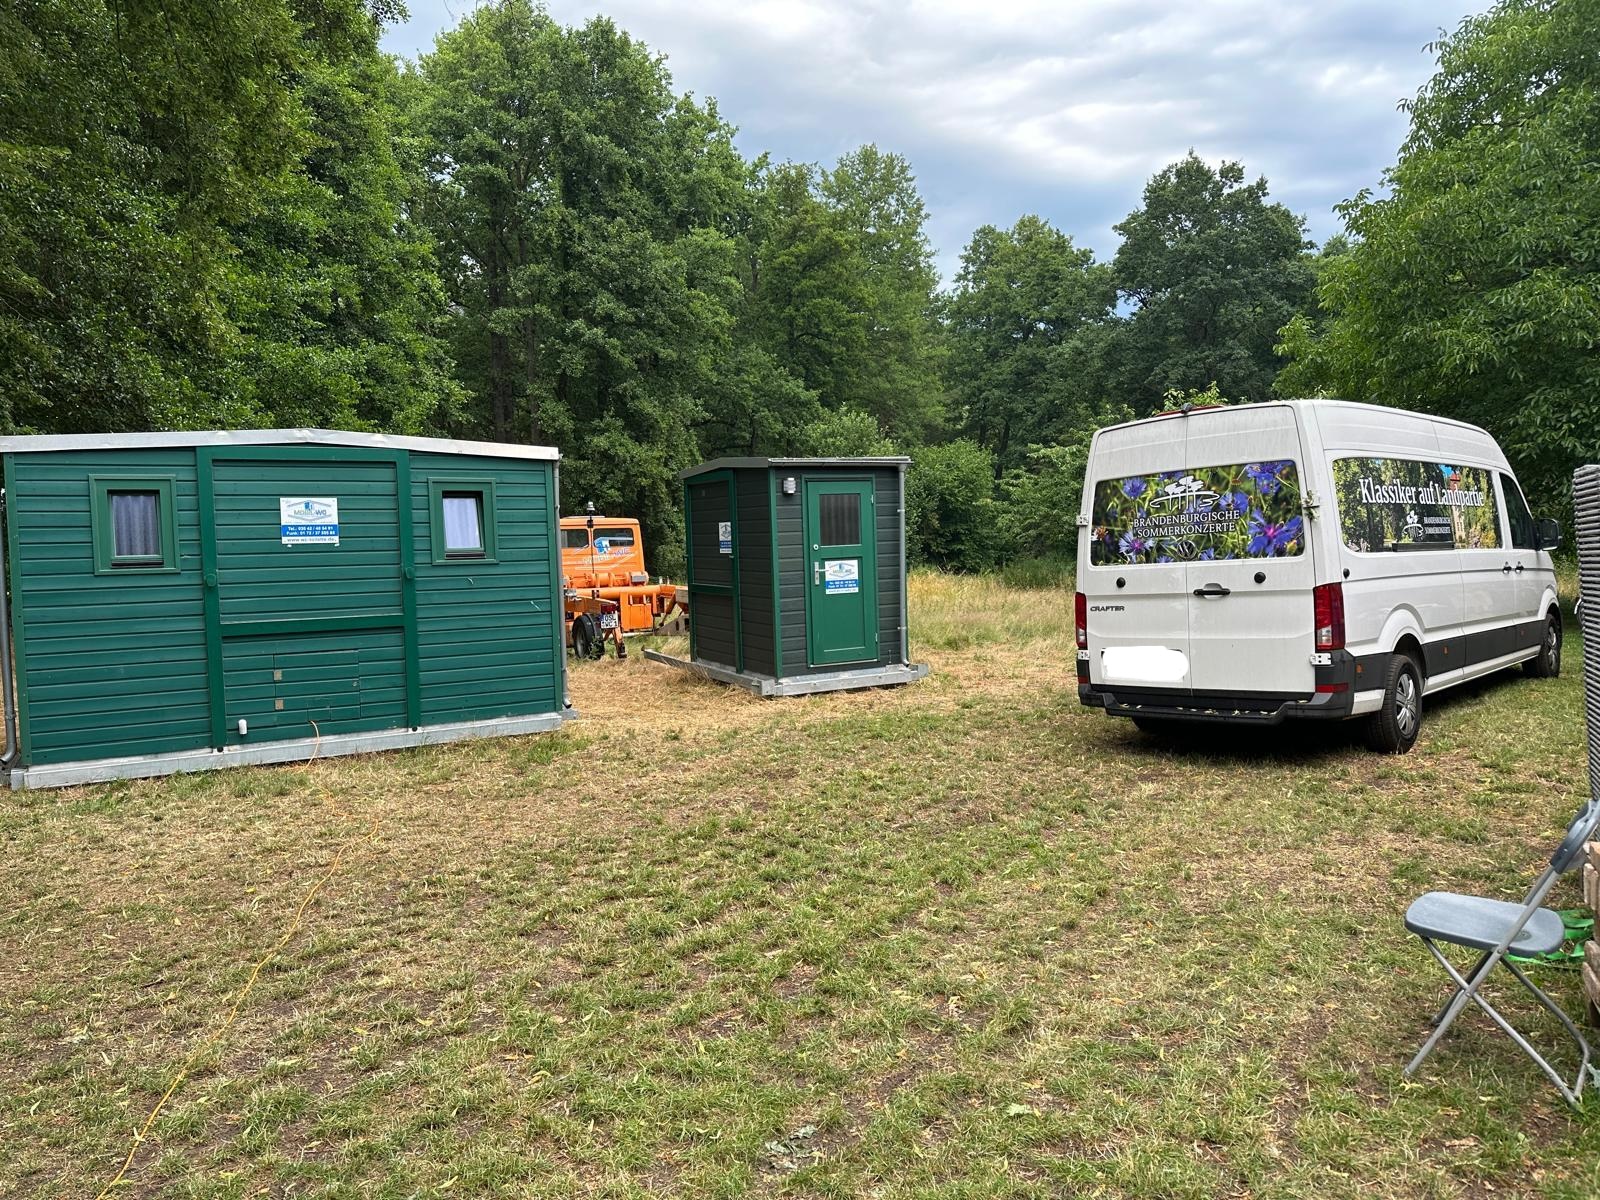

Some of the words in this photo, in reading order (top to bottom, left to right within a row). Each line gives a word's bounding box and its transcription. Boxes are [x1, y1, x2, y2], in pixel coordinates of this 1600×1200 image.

[1358, 477, 1416, 505] Klassiker
[1418, 481, 1435, 505] auf
[1436, 483, 1485, 508] Landpartie
[1134, 510, 1240, 528] BRANDENBURGISCHE
[1136, 522, 1236, 539] SOMMERKONZERTE
